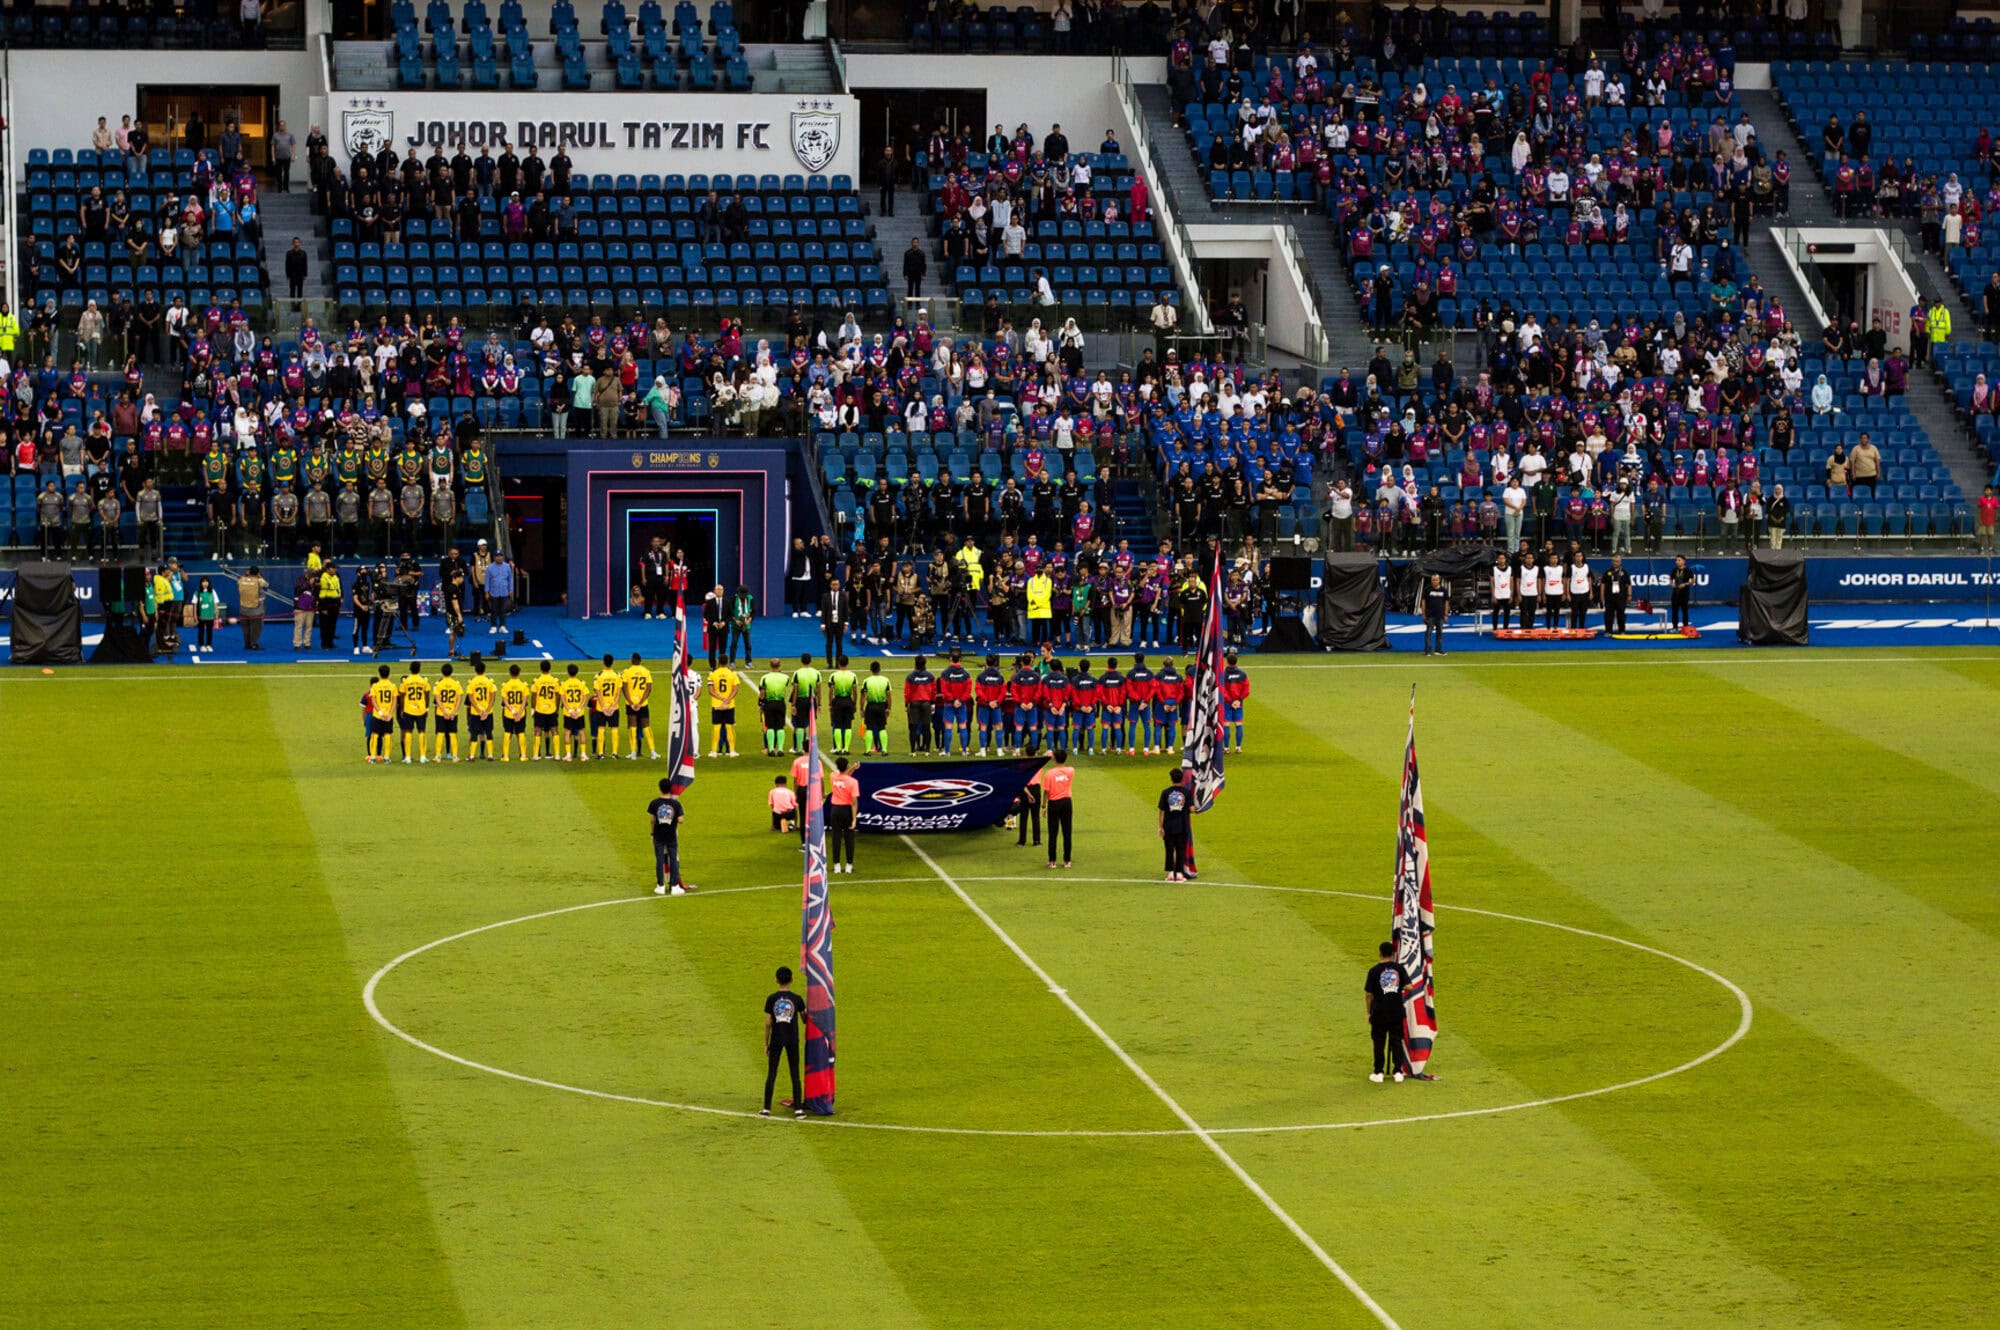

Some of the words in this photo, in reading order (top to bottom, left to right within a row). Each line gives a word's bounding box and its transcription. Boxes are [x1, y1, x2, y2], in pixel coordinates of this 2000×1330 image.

[407, 121, 507, 147] JOHOR
[518, 121, 616, 148] DARUL
[624, 122, 723, 148] TA'ZIM
[737, 122, 770, 148] FC
[1839, 573, 1903, 585] JOHOR
[1907, 573, 1968, 585] DARUL
[602, 682, 615, 696] 21
[631, 676, 647, 690] 72
[719, 678, 727, 692] 6
[378, 689, 392, 703] 19
[440, 689, 456, 703] 82
[475, 687, 487, 701] 31
[507, 690, 523, 704] 80
[566, 689, 581, 703] 33
